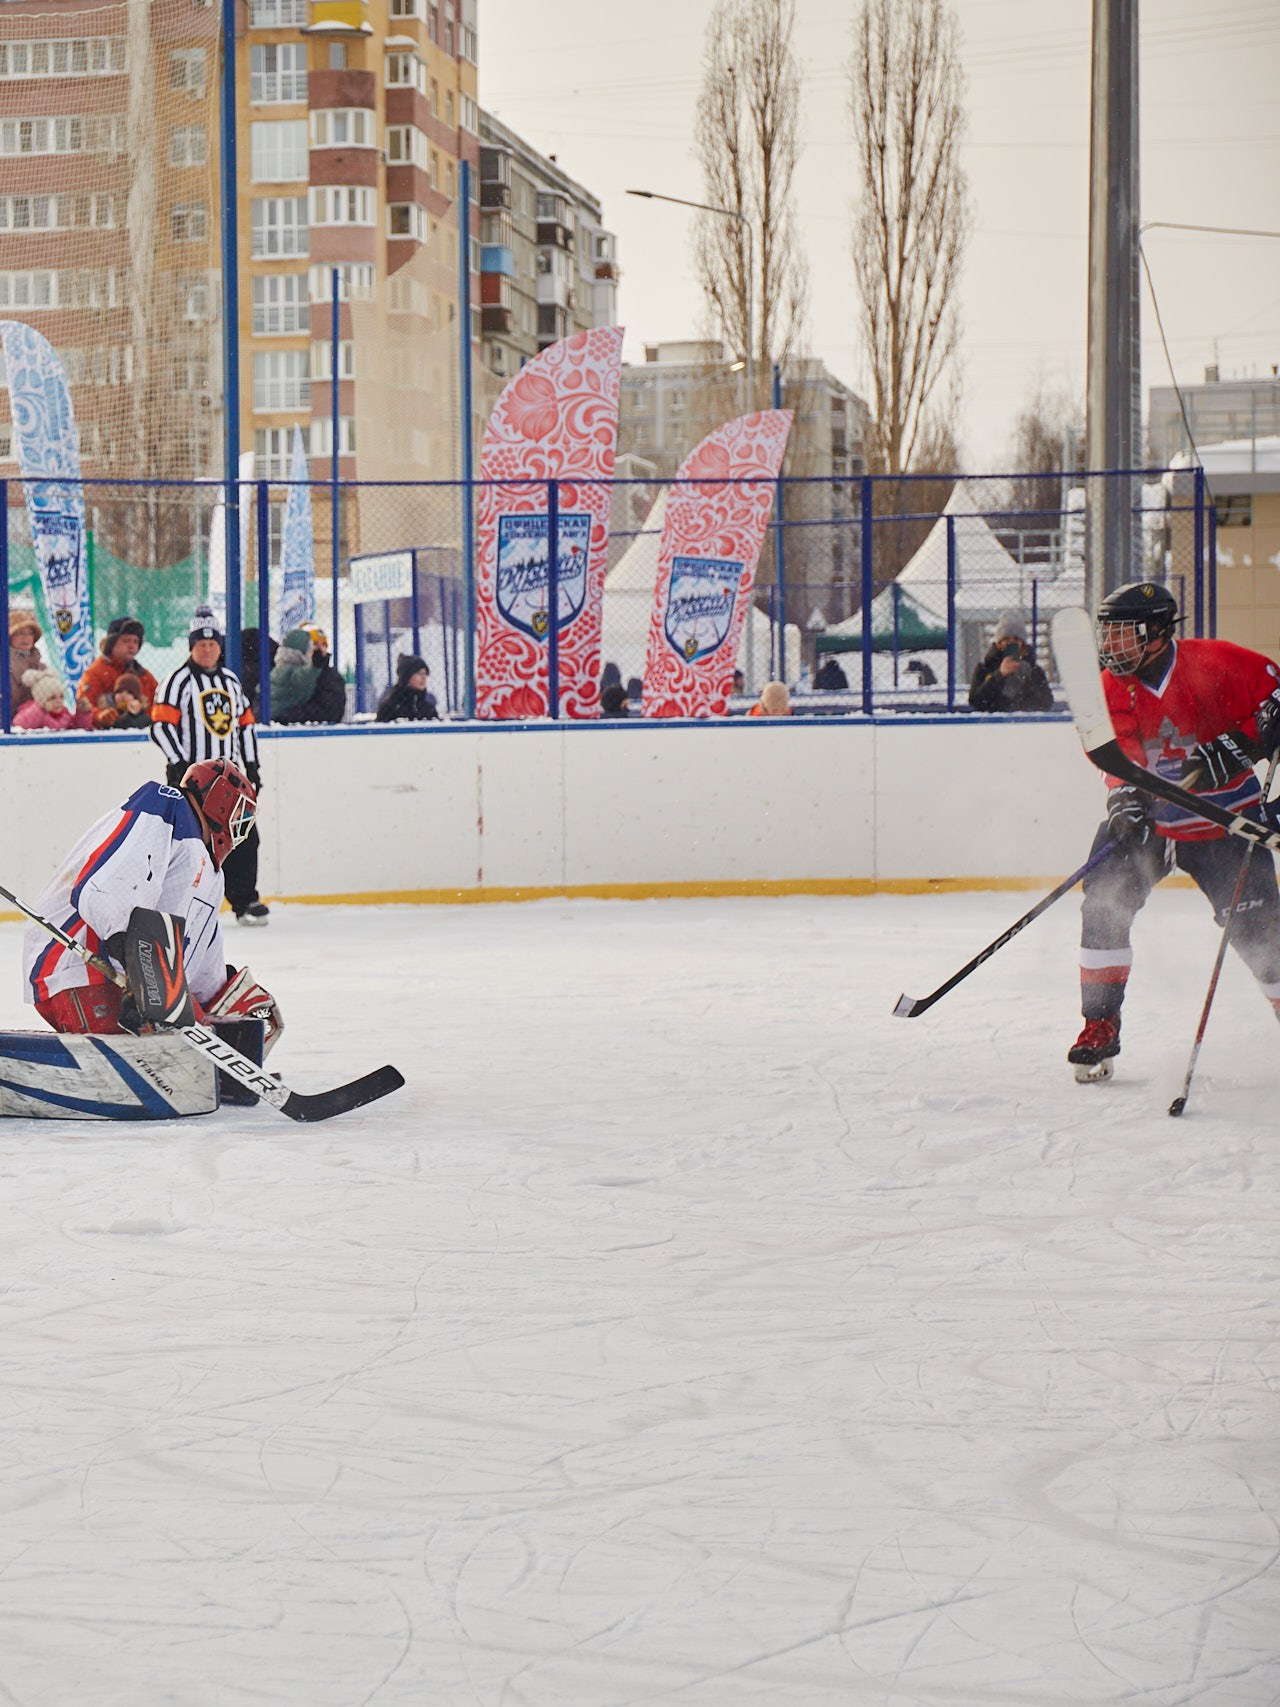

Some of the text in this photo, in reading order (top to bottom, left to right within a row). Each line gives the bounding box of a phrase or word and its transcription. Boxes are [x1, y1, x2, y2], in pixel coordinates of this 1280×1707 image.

[504, 519, 587, 529] ОФИЦЕСКАЯ
[138, 939, 162, 1006] VAUGHN
[183, 1028, 278, 1095] AUER
